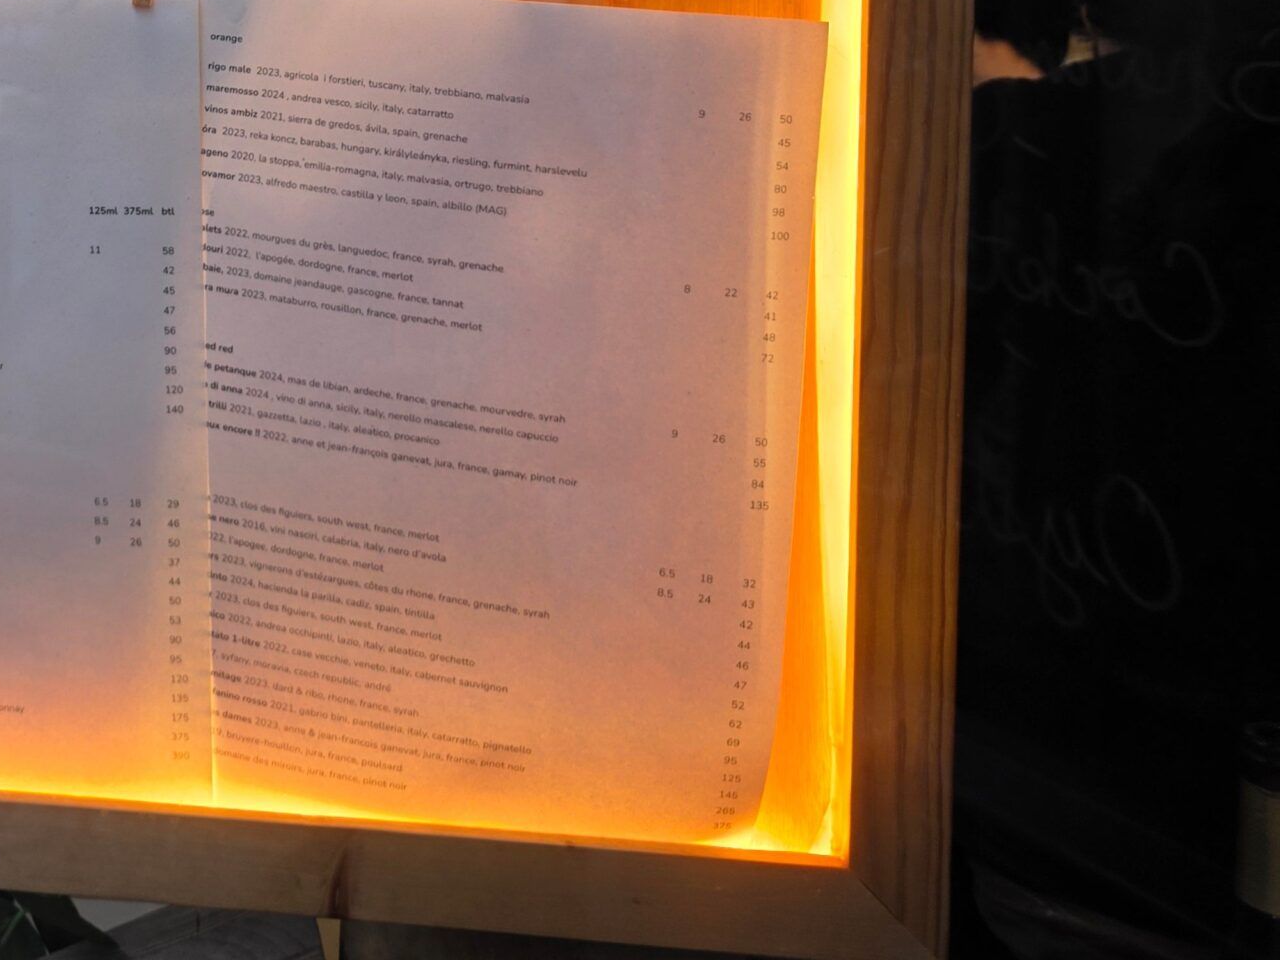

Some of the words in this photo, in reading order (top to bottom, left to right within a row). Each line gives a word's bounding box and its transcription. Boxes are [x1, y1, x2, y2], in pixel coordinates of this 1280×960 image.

[210, 34, 242, 43] orange
[739, 112, 751, 121] 26
[780, 114, 792, 124] 50
[89, 206, 117, 214] 125ml
[124, 206, 153, 215] 375ml
[90, 245, 100, 254] 11
[162, 246, 174, 255] 58
